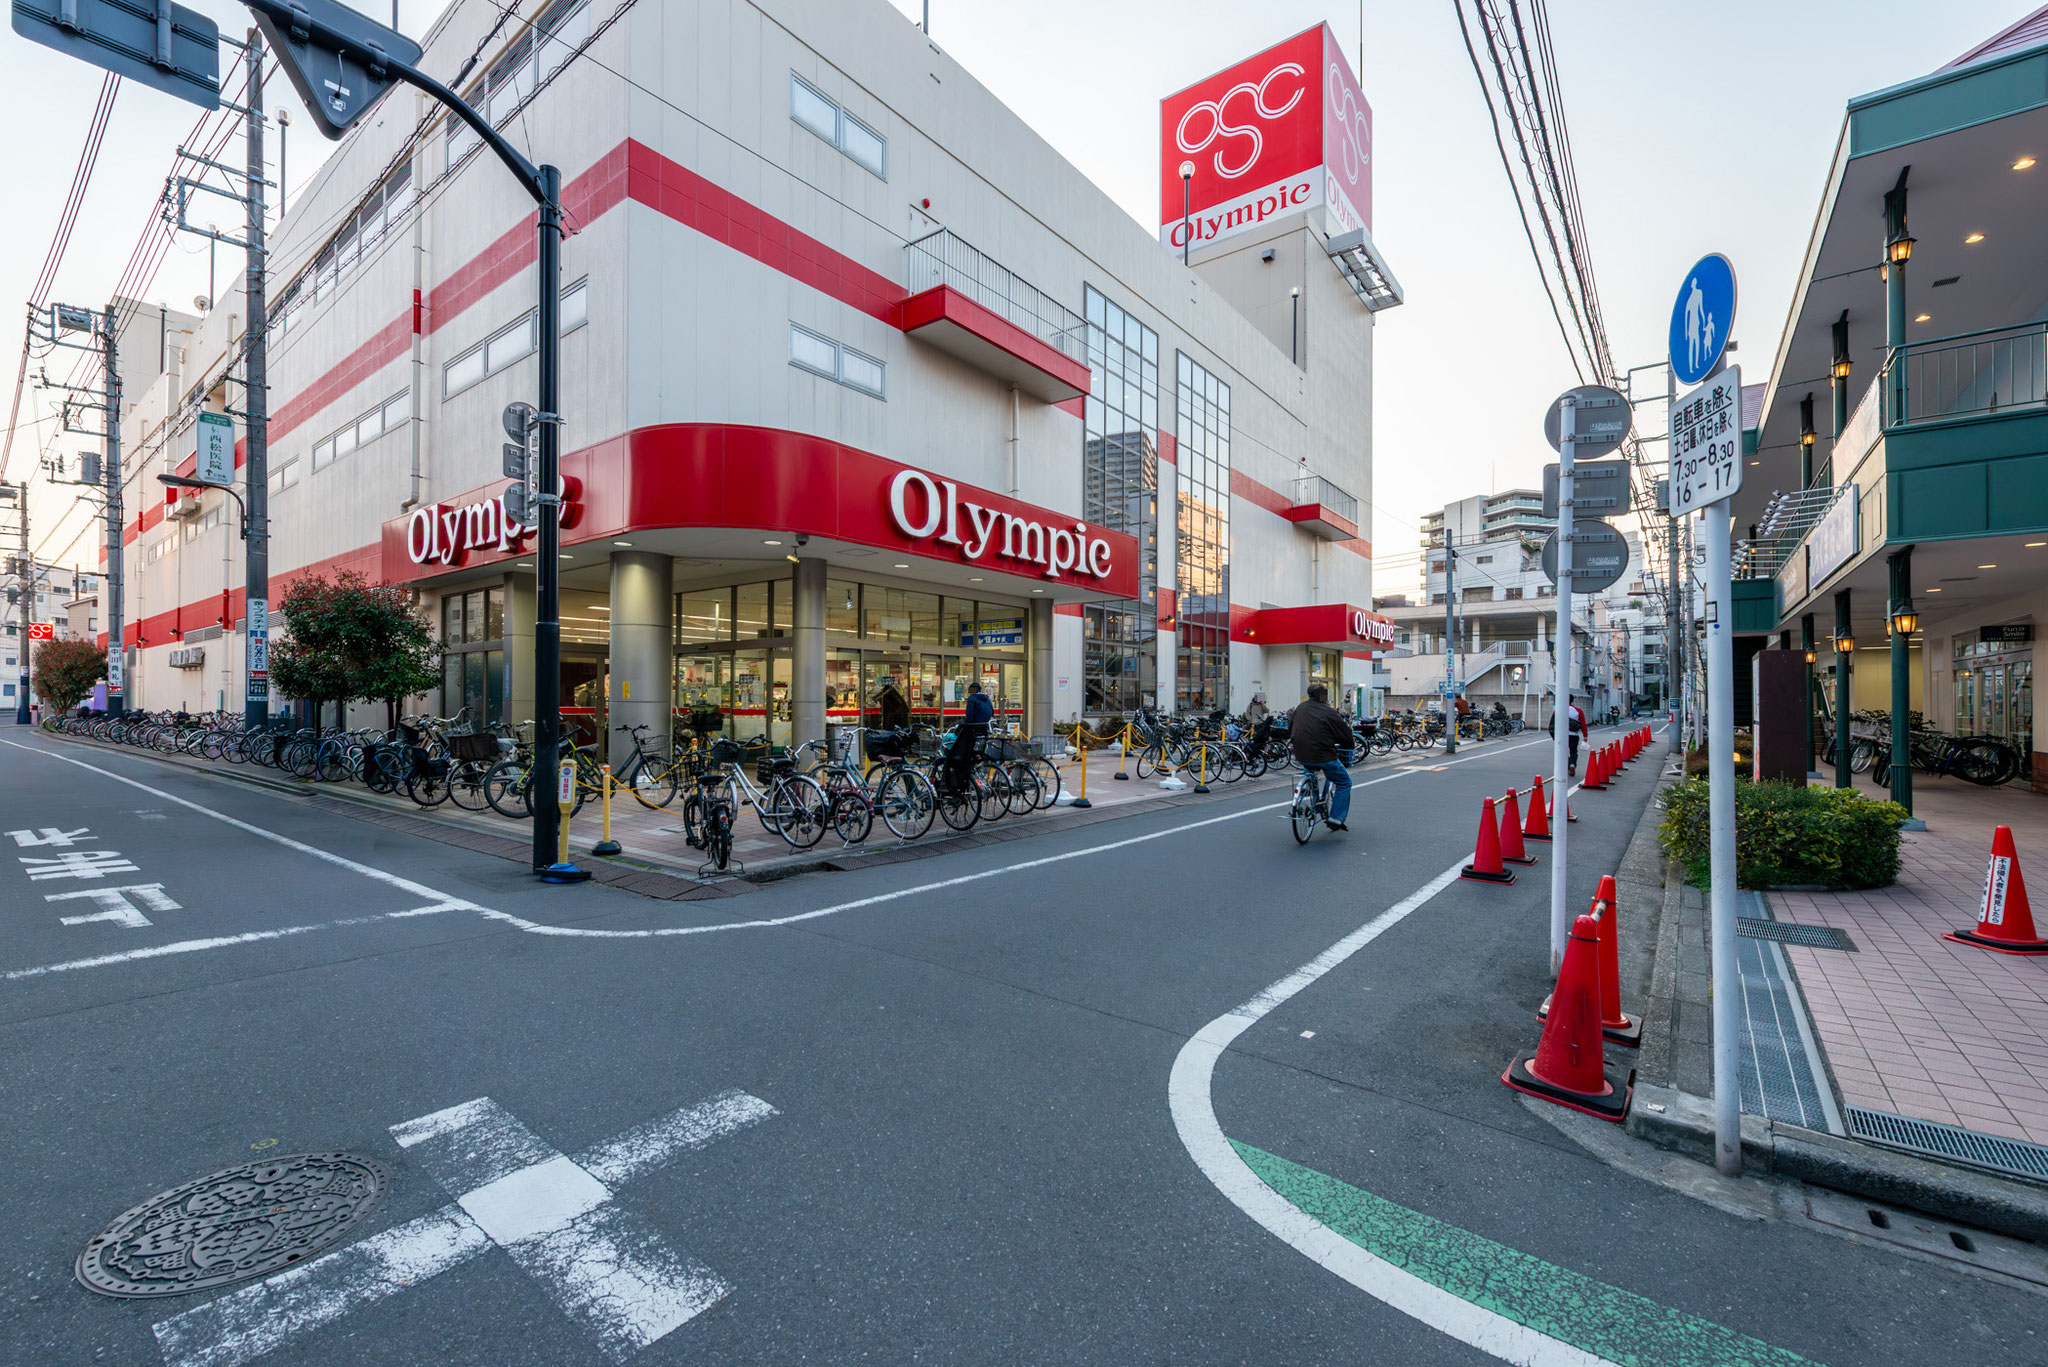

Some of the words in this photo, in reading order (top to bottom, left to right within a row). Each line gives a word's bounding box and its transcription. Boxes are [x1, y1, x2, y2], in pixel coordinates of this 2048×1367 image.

[1170, 183, 1312, 247] Olympic
[1327, 176, 1360, 231] Olym
[1673, 385, 1732, 434] 自転車を除く
[210, 433, 222, 470] 西松医院
[407, 474, 567, 565] Olymp
[890, 469, 1112, 578] Olympic
[1355, 611, 1394, 643] Olympic
